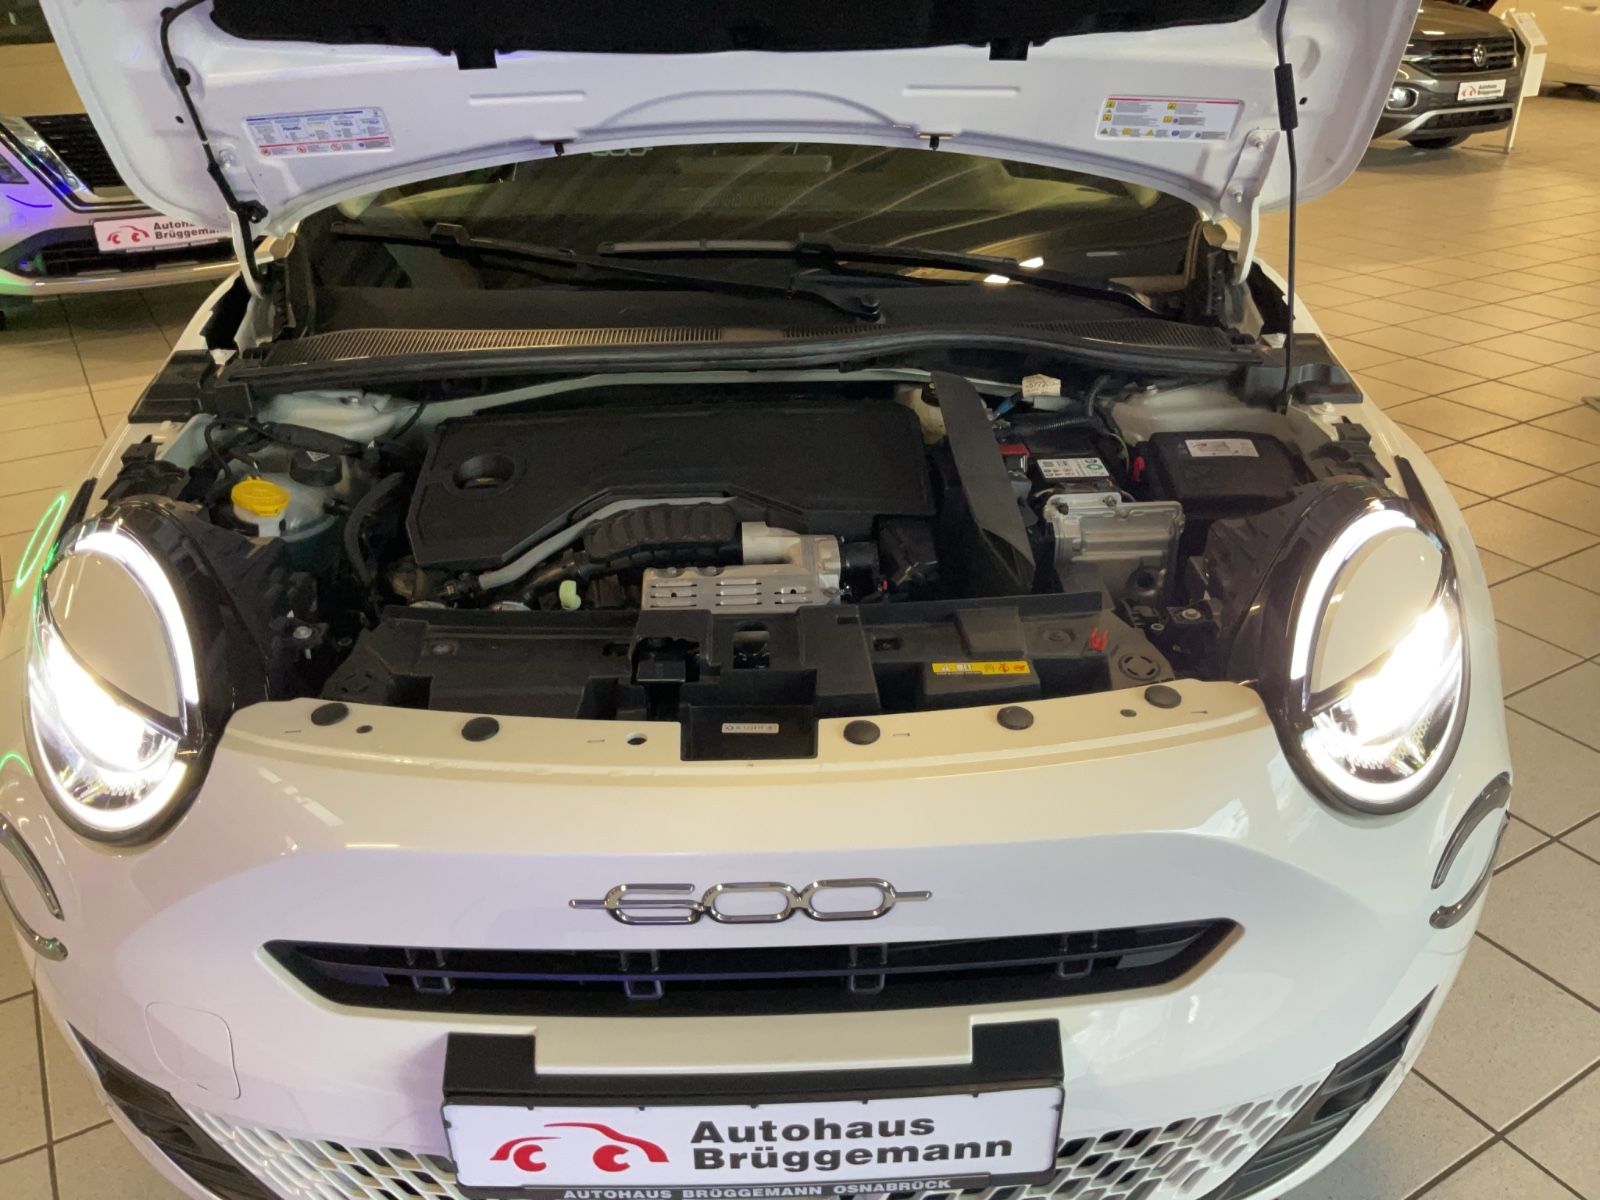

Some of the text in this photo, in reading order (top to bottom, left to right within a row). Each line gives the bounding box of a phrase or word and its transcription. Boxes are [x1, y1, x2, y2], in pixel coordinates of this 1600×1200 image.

[153, 221, 195, 230] Autoh
[154, 228, 220, 240] Brüggem
[690, 1117, 936, 1144] Autohaus
[693, 1138, 1013, 1173] Brüggemann
[563, 1179, 951, 1200] AUTOHAUS BRÜGGEMANN OSNABRÜCK
